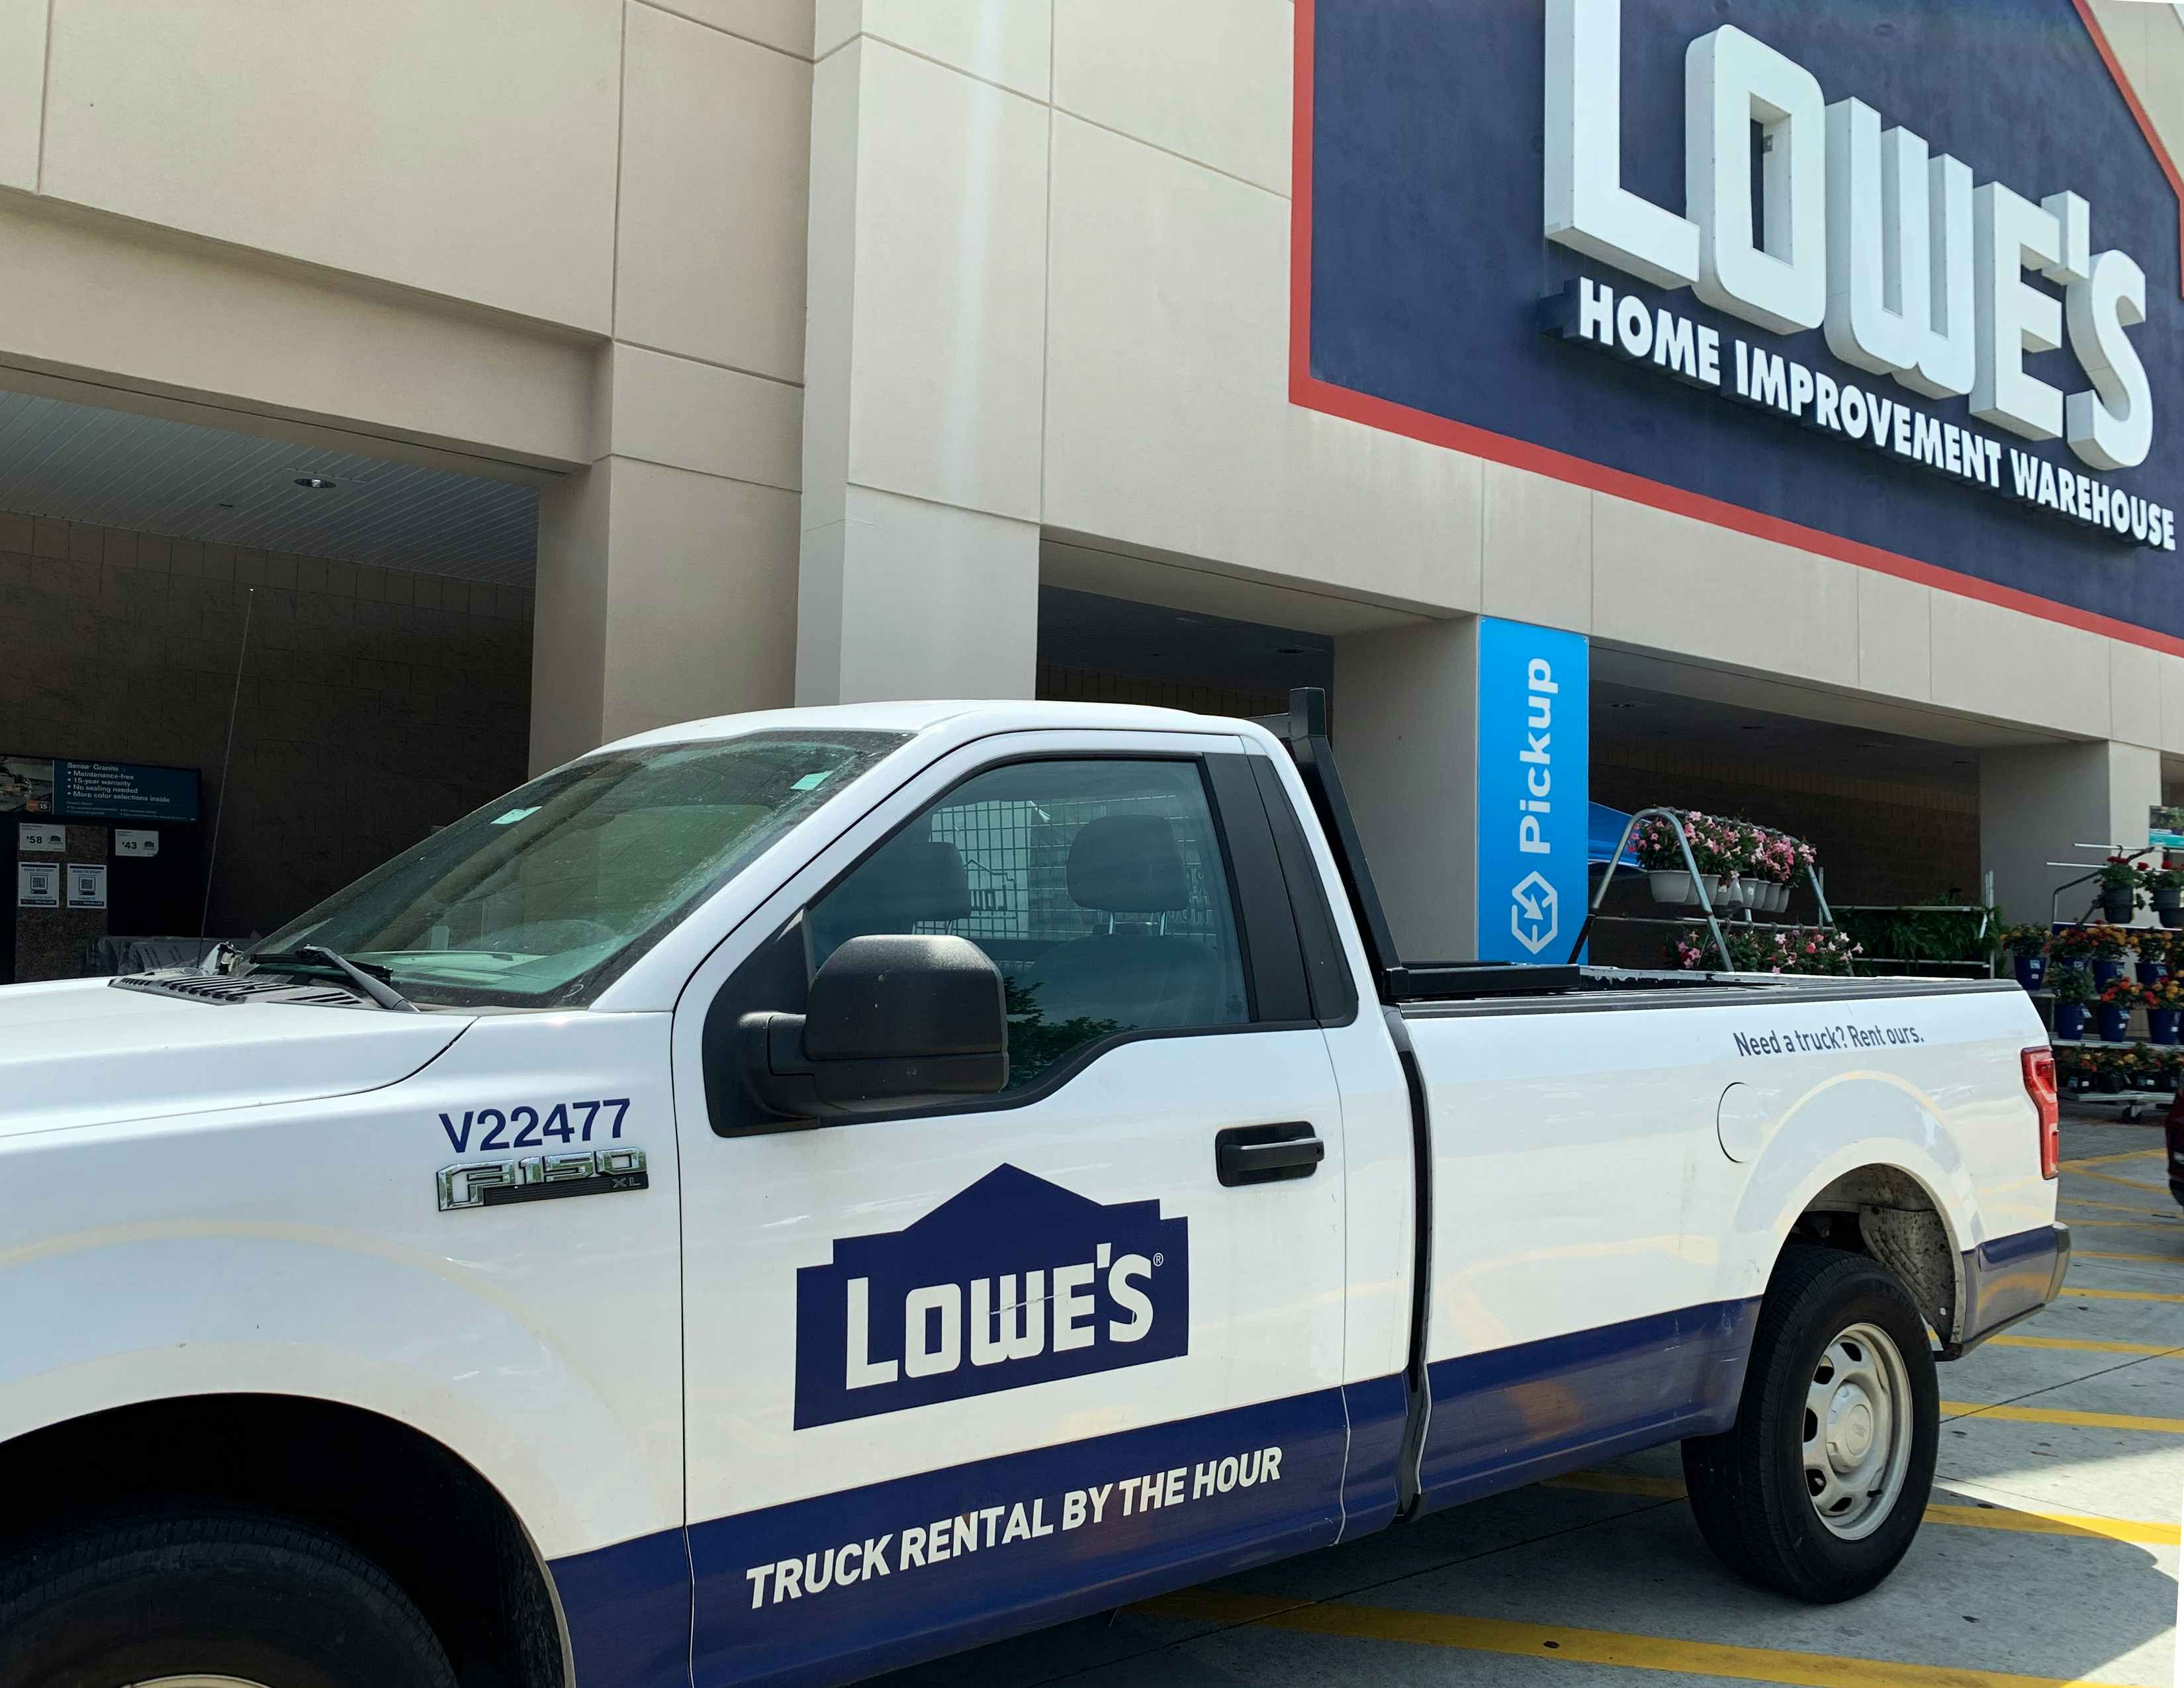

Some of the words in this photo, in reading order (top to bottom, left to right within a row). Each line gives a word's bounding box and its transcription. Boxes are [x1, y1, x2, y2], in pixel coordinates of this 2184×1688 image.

[1545, 0, 2154, 471] LOWE'S
[1579, 277, 1721, 387] HOME
[1735, 340, 2002, 489] IMPROVEMENT
[2010, 448, 2177, 551] WAREHOUSE
[73, 771, 134, 780] Maintenance-free
[73, 777, 100, 786] 15-year
[1520, 657, 1559, 854] Pickup
[1733, 1030, 1782, 1056] Need
[1784, 1034, 1796, 1053] a
[1795, 1026, 1848, 1051] truck?
[1846, 1025, 1886, 1048] Rent
[1886, 1027, 1925, 1045] ours.
[438, 1098, 631, 1154] V22477
[436, 1147, 648, 1212] F150
[612, 1176, 641, 1189] XL
[745, 1533, 895, 1609] TRUCK
[899, 1499, 1054, 1571] RENTAL
[1062, 1483, 1115, 1532] BY
[1118, 1466, 1189, 1517] THE
[1193, 1446, 1283, 1500] HOUR
